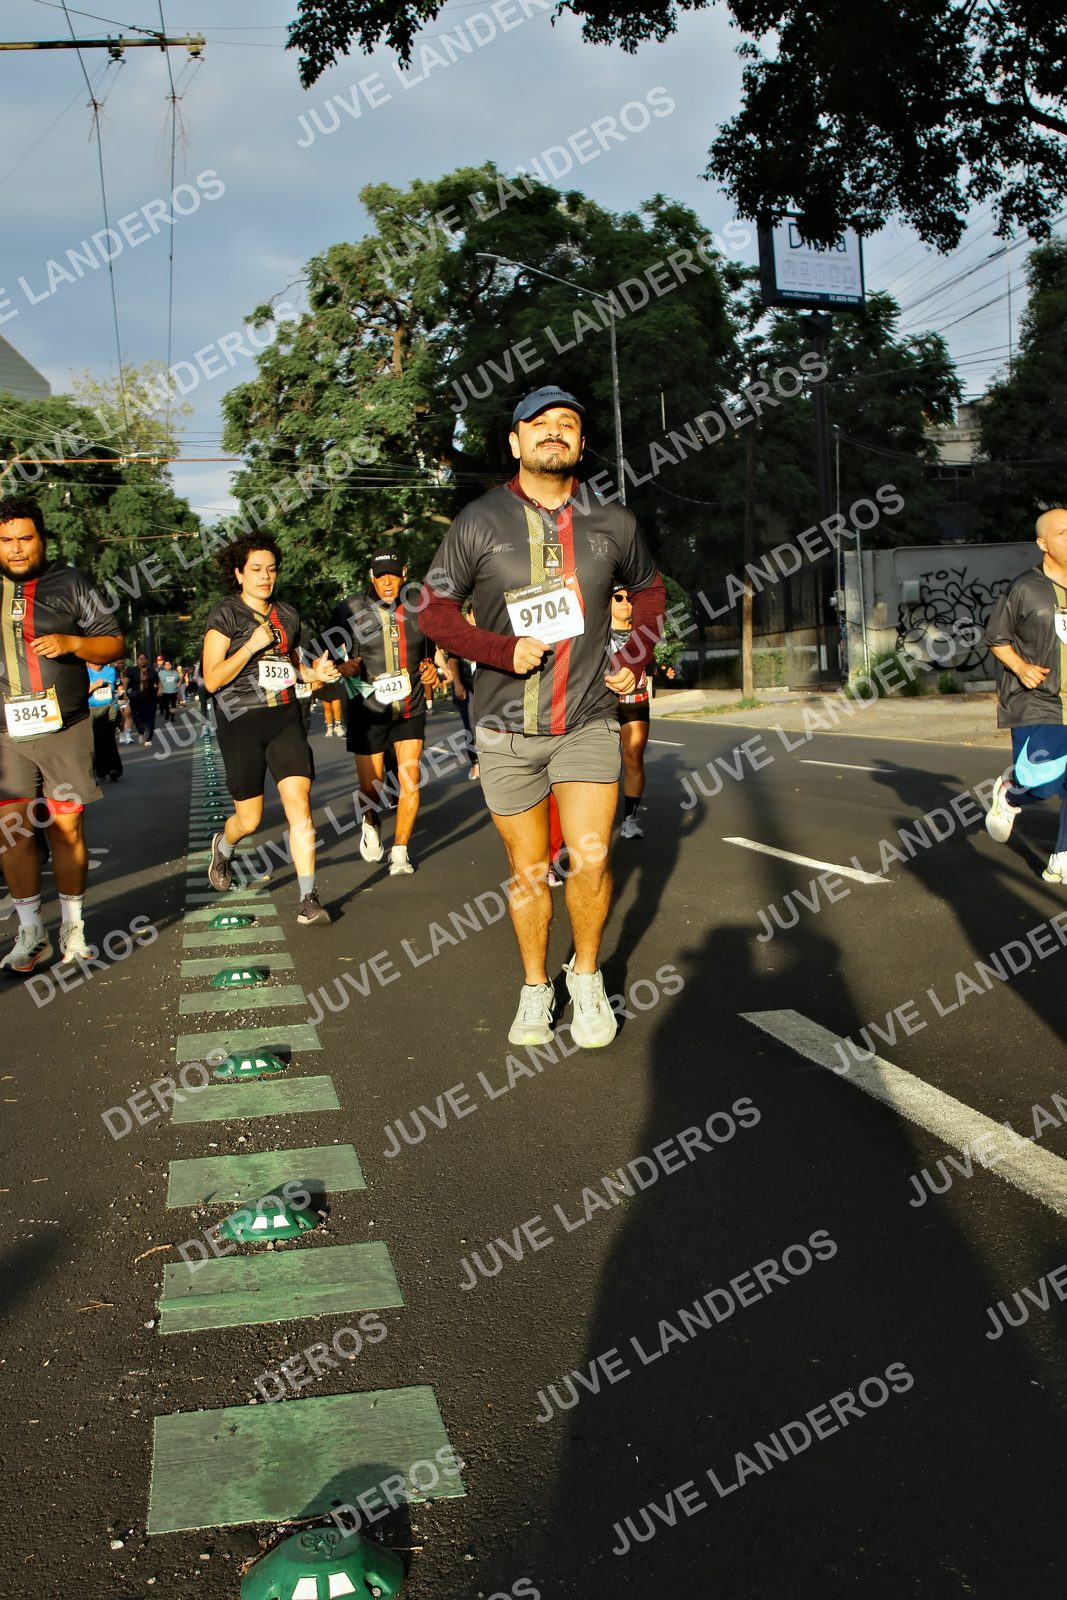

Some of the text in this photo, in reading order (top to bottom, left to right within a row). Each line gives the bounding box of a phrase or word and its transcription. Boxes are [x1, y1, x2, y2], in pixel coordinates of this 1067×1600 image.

[920, 566, 968, 584] TOY
[520, 596, 570, 628] 9704
[265, 666, 290, 678] 3528
[378, 680, 403, 694] 4421
[12, 704, 48, 722] 3845
